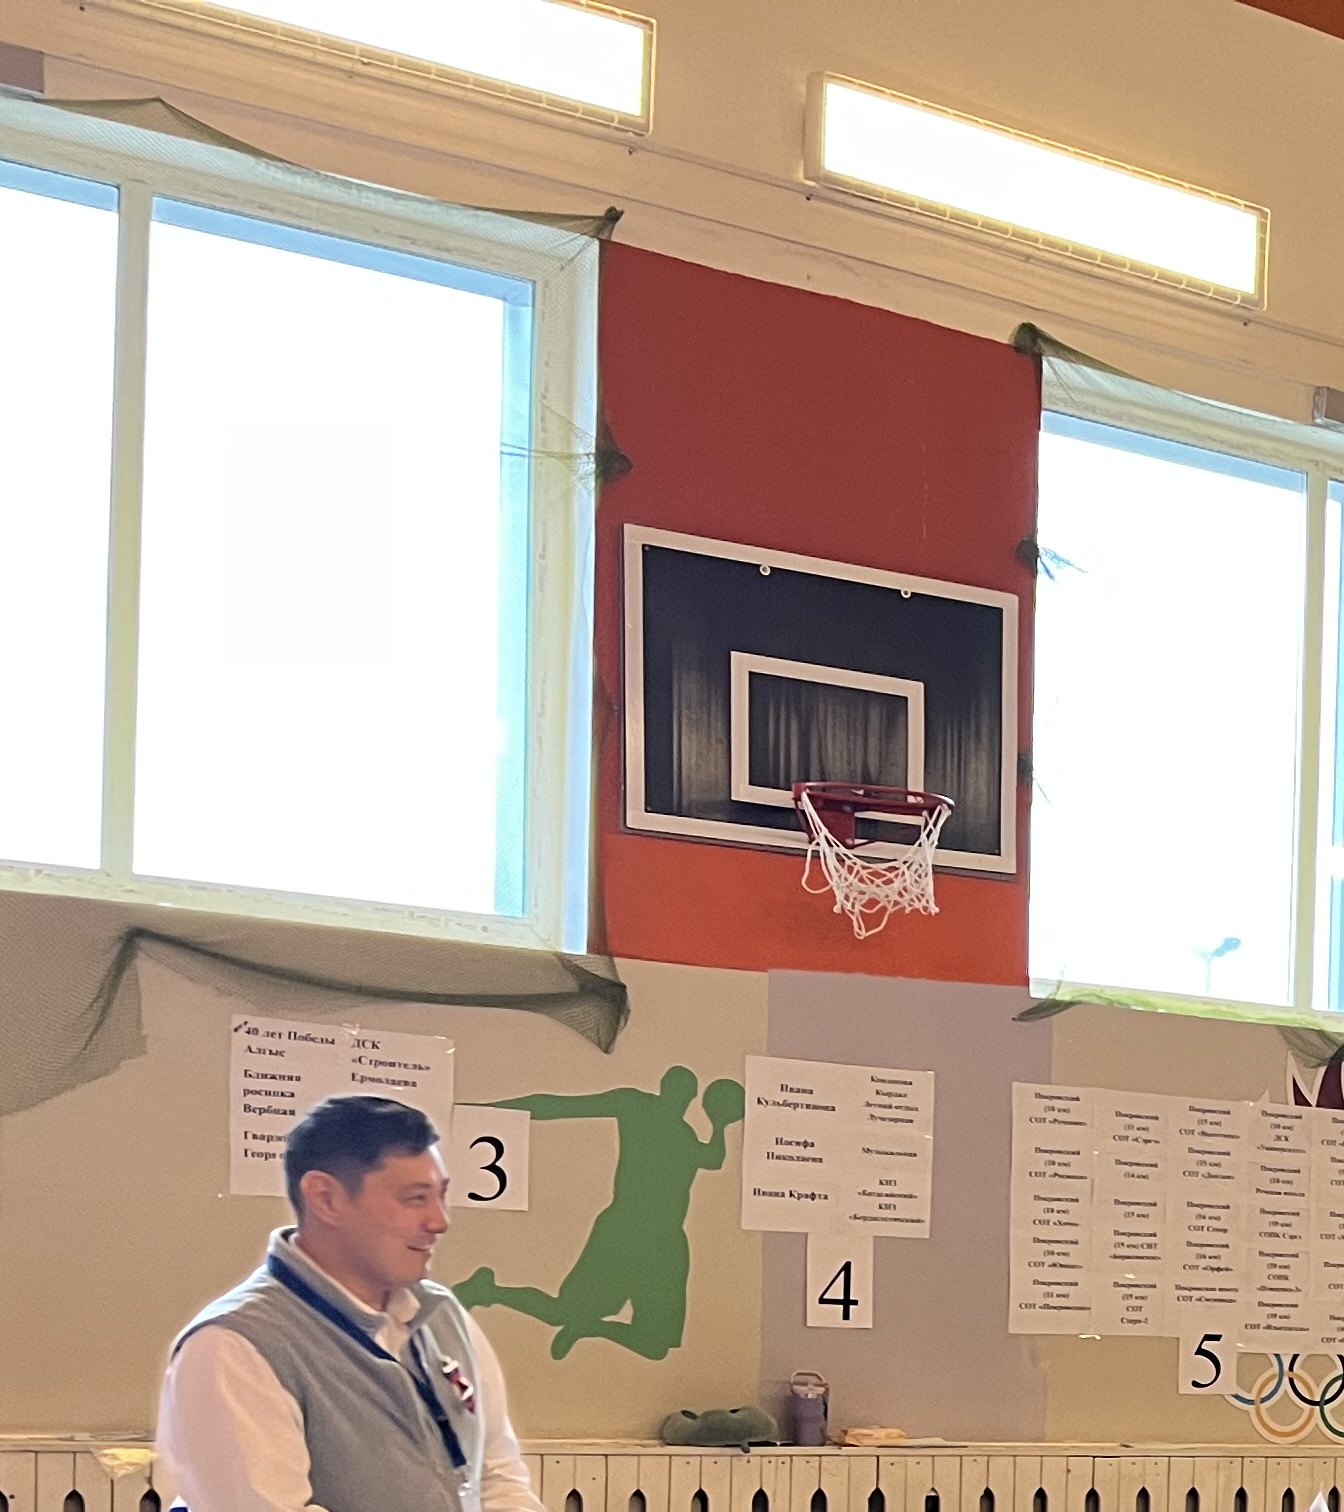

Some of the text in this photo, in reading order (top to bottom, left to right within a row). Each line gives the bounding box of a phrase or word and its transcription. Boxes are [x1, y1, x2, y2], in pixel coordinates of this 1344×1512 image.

[261, 1030, 283, 1041] лет
[287, 1031, 336, 1046] Победы
[352, 1038, 382, 1050] ДСК
[467, 1136, 508, 1202] 3
[817, 1260, 859, 1321] 4
[1191, 1334, 1223, 1388] 5
